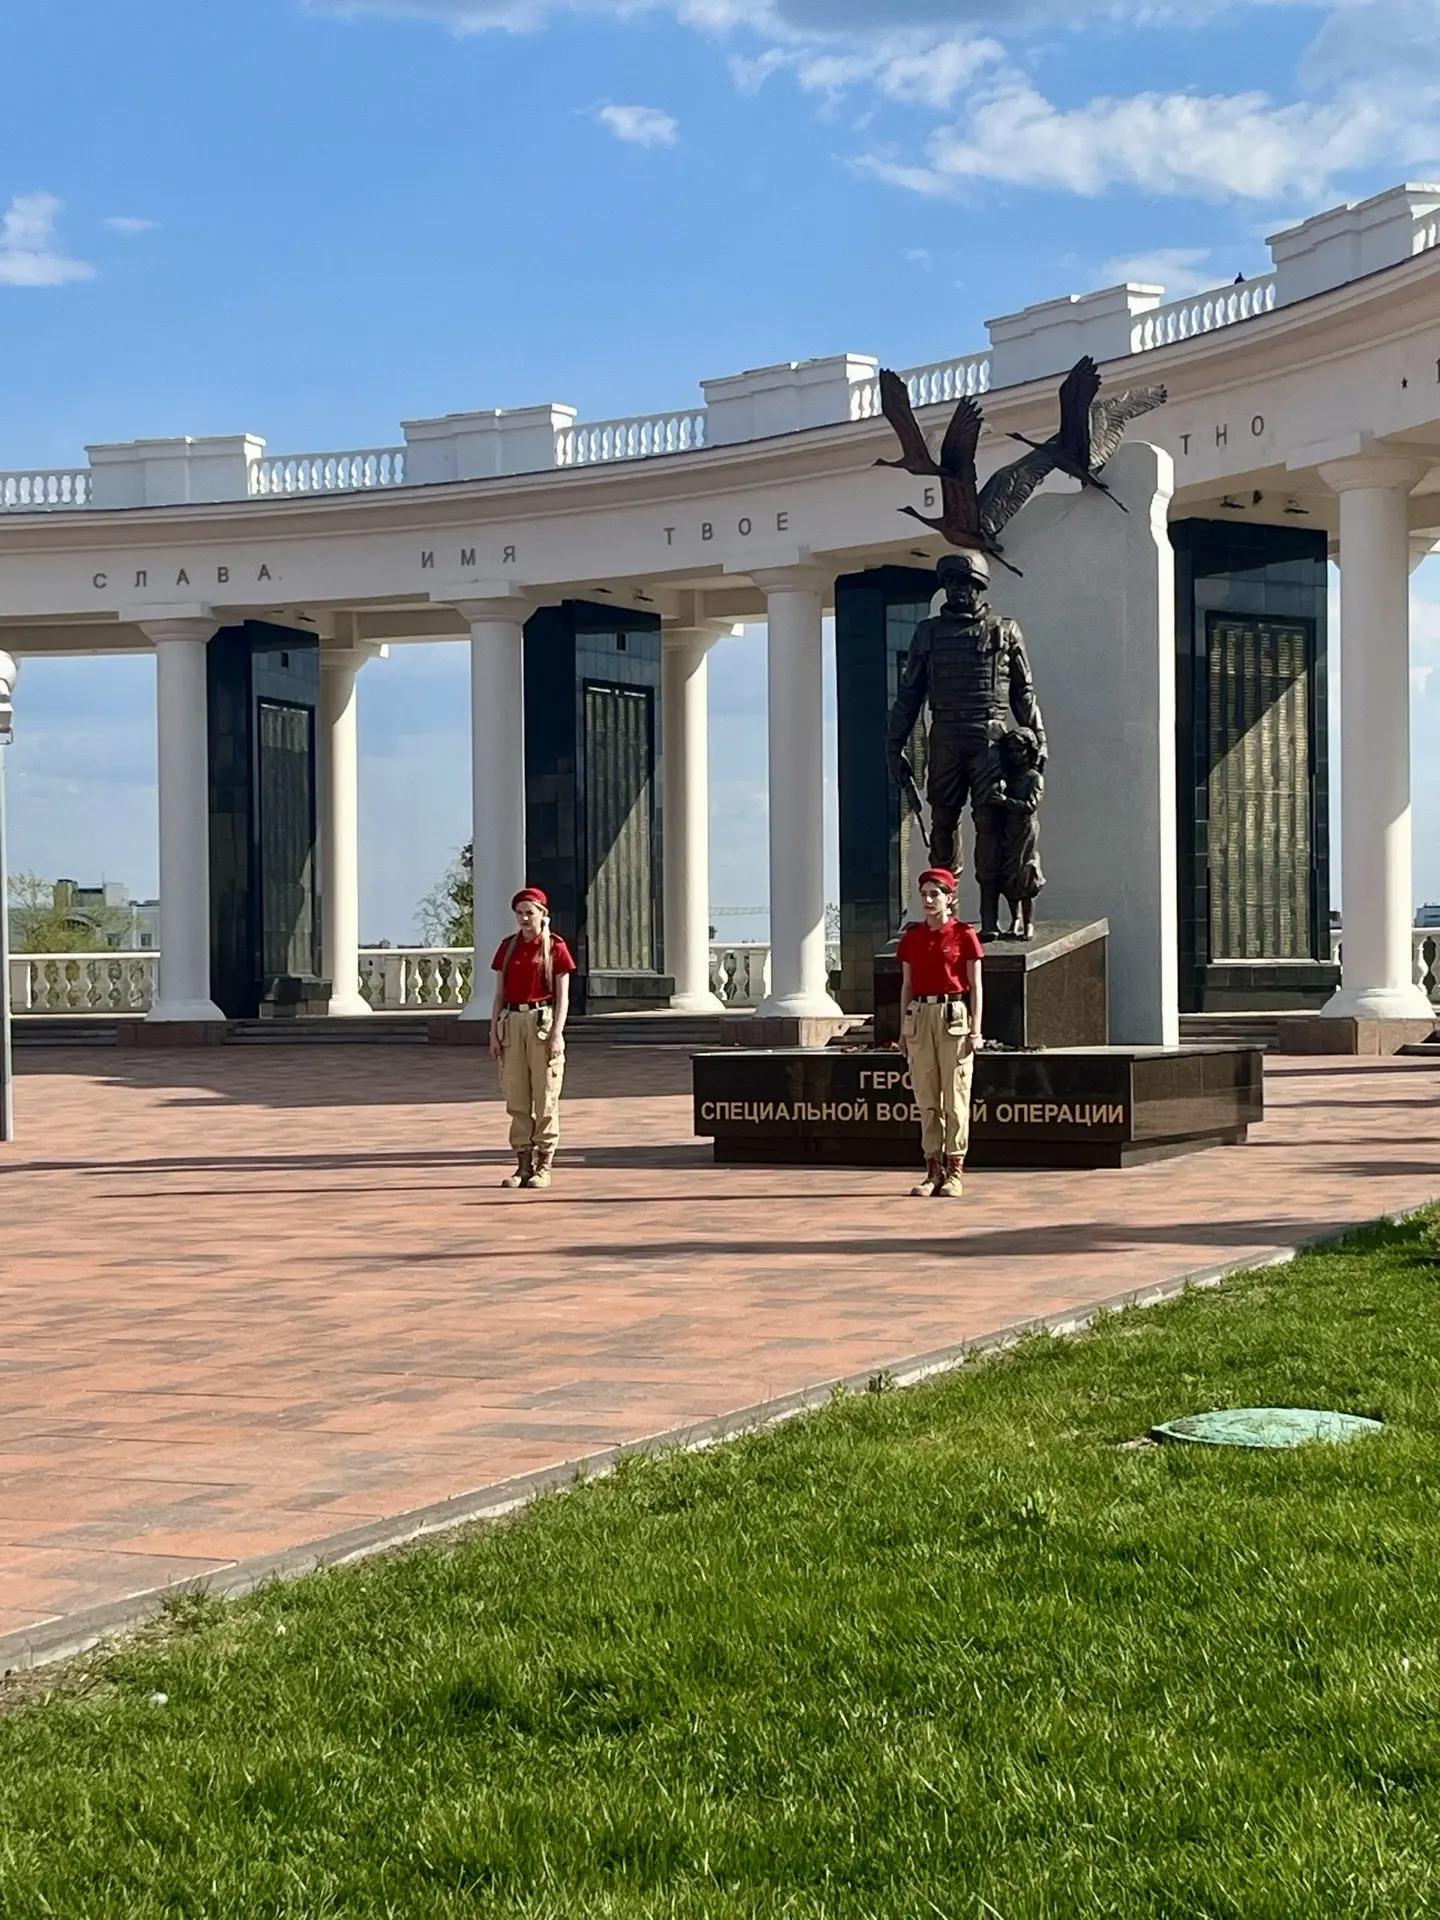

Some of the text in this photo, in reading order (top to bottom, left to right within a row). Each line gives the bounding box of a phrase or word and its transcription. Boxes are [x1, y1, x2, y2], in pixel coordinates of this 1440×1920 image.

[421, 545, 516, 569] ИМЯ
[663, 511, 790, 546] ТВОЕ
[860, 1071, 913, 1090] ГЕРО
[701, 1097, 1124, 1127] СПЕЦИАЛЬНОЙ ВОЕЙ ОПЕРАЦИИ
